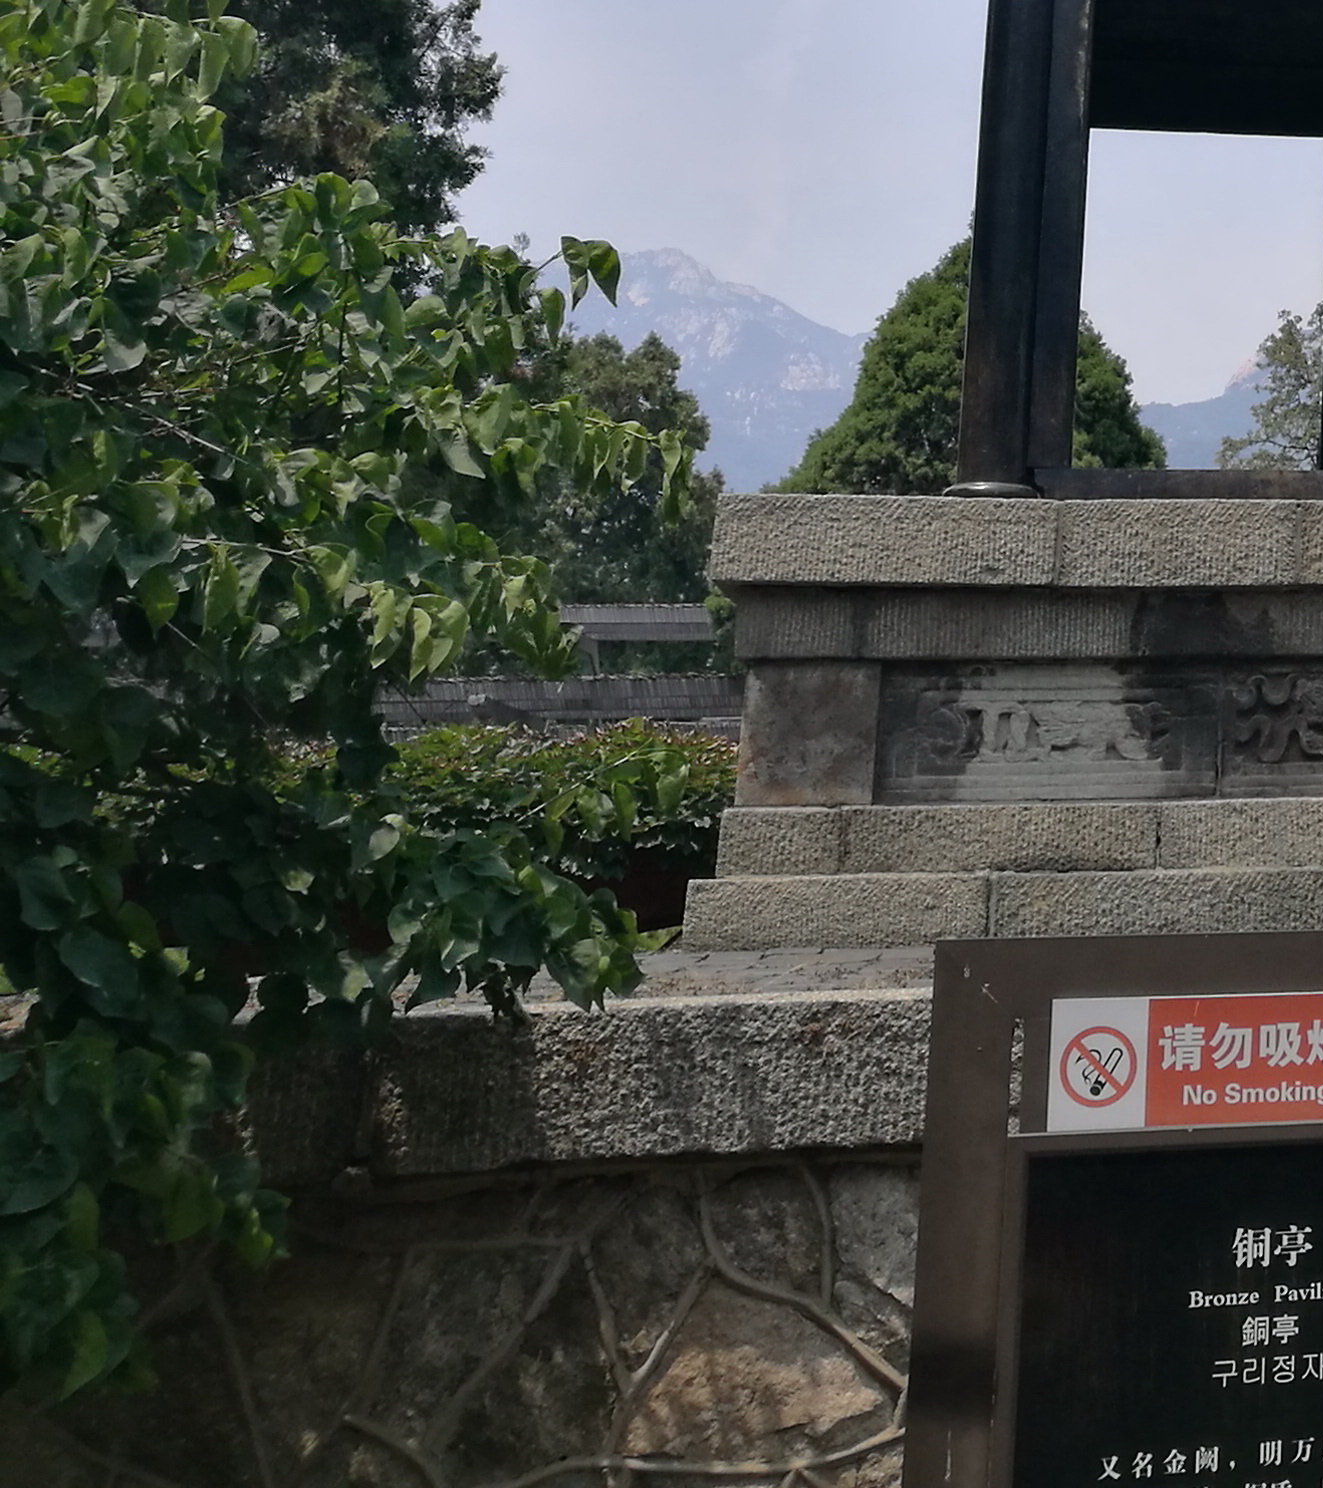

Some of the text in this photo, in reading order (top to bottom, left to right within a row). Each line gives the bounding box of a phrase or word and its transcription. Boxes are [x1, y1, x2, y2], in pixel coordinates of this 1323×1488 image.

[1182, 1085, 1217, 1106] No
[1232, 1224, 1313, 1268] 铜亭
[1188, 1290, 1260, 1309] Bronze
[1242, 1313, 1299, 1347] 銅亭
